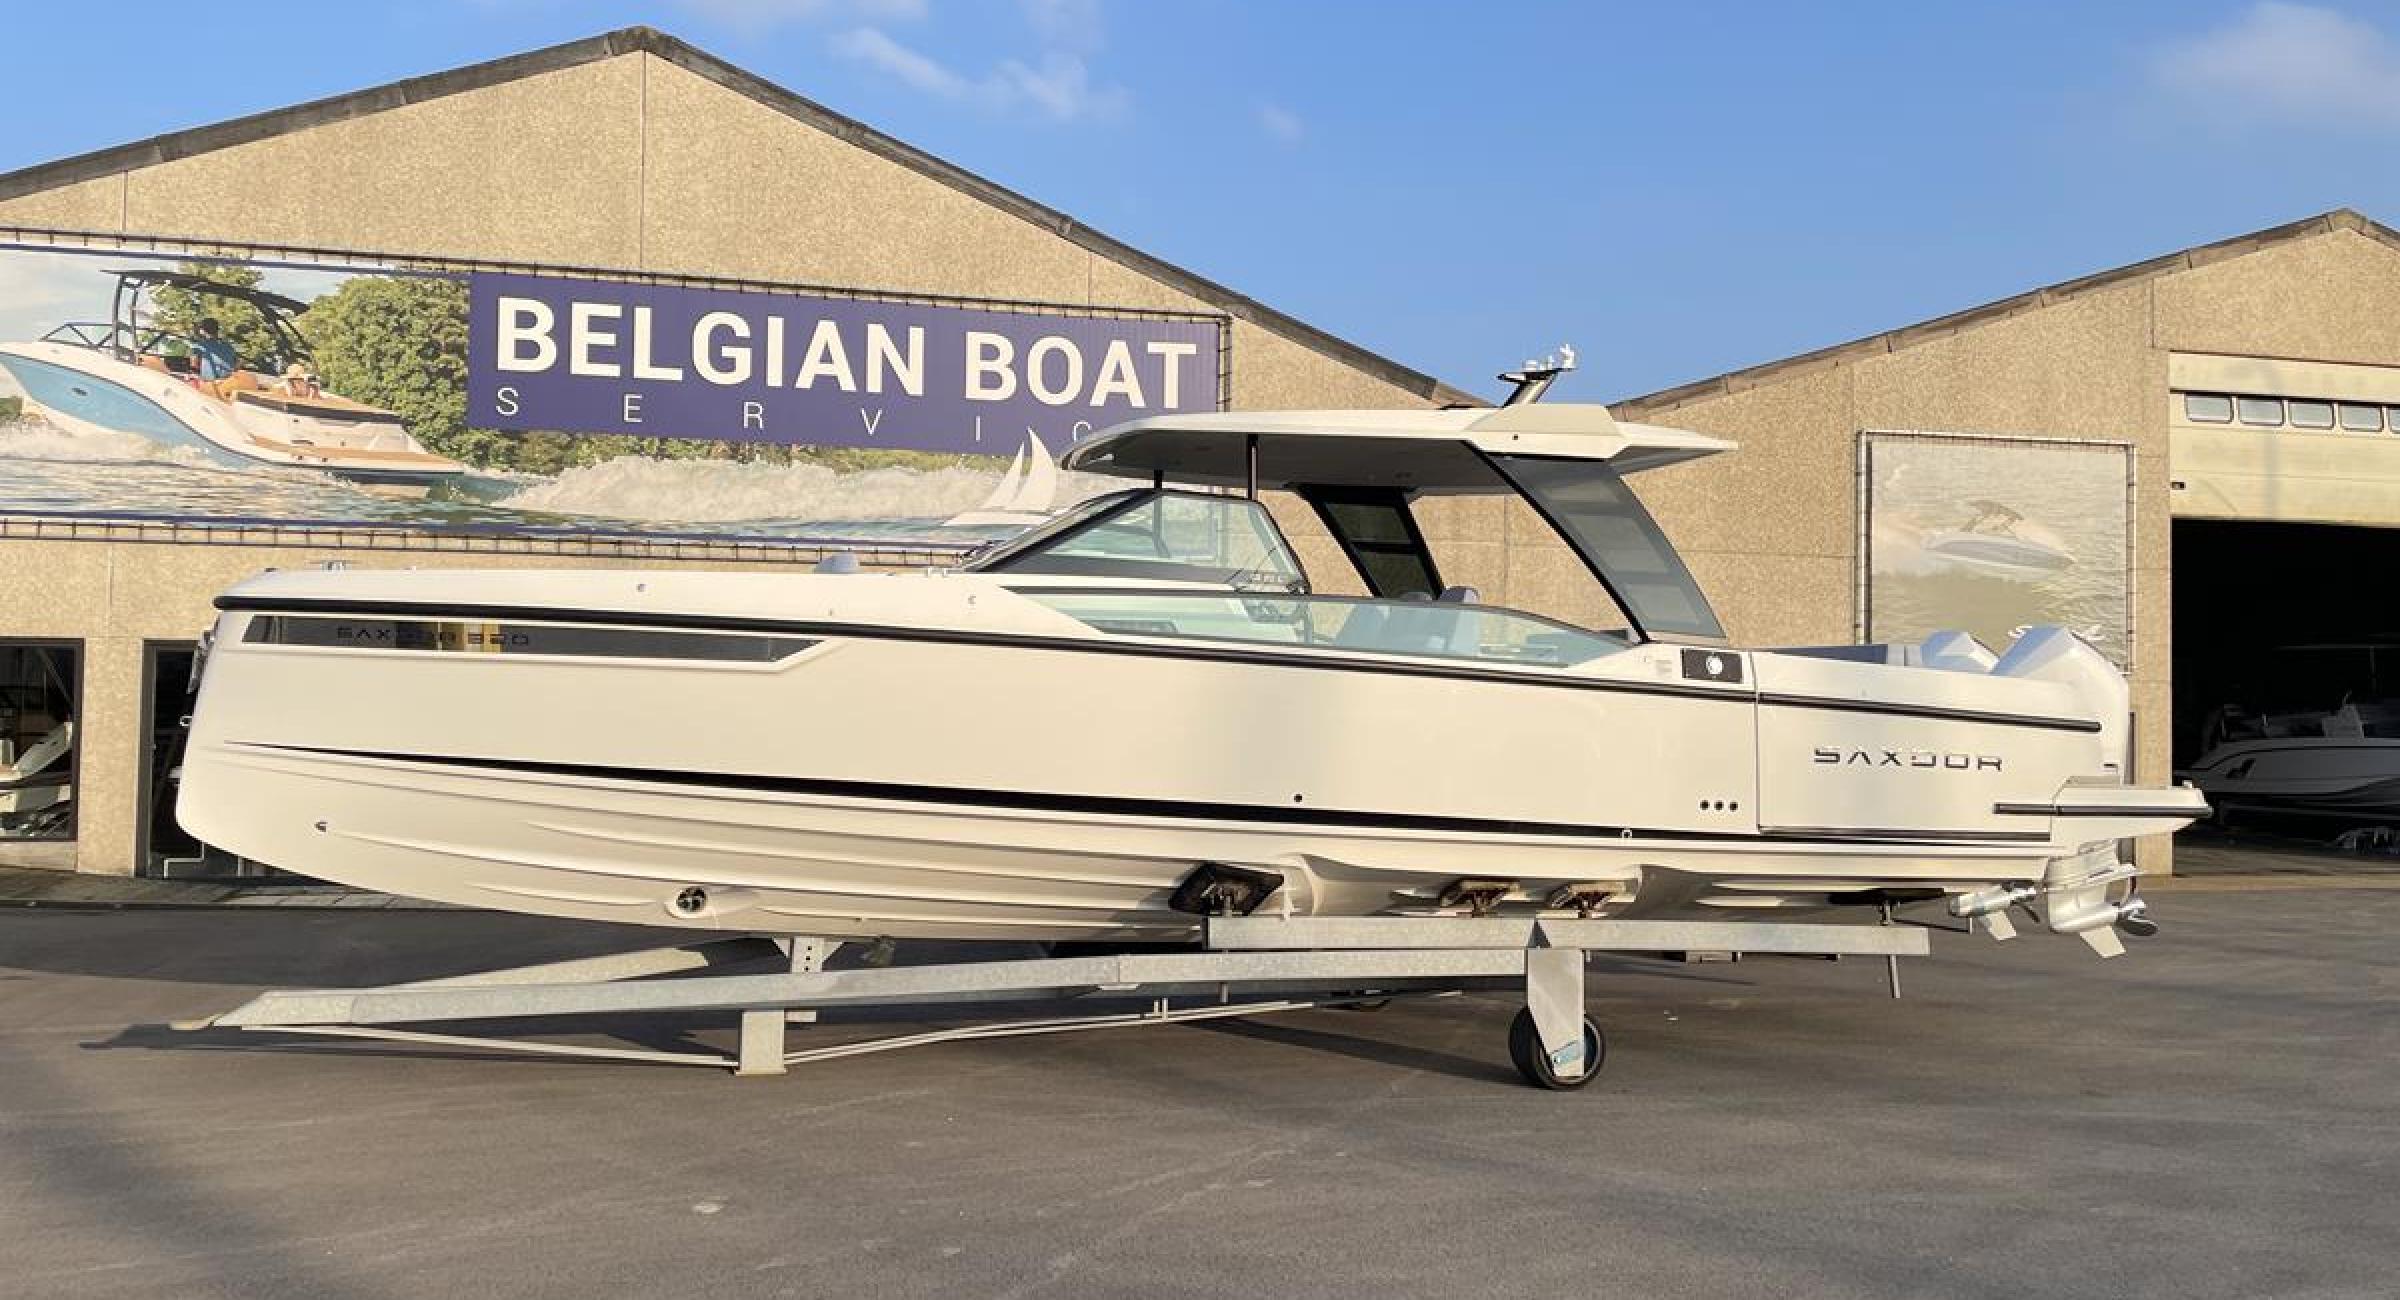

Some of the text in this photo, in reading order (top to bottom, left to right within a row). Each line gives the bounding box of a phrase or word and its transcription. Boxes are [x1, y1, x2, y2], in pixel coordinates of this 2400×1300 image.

[497, 297, 1197, 409] BELGIAN BOAT
[496, 387, 1091, 442] SERVIC
[1813, 746, 2003, 771] SAXDOR
